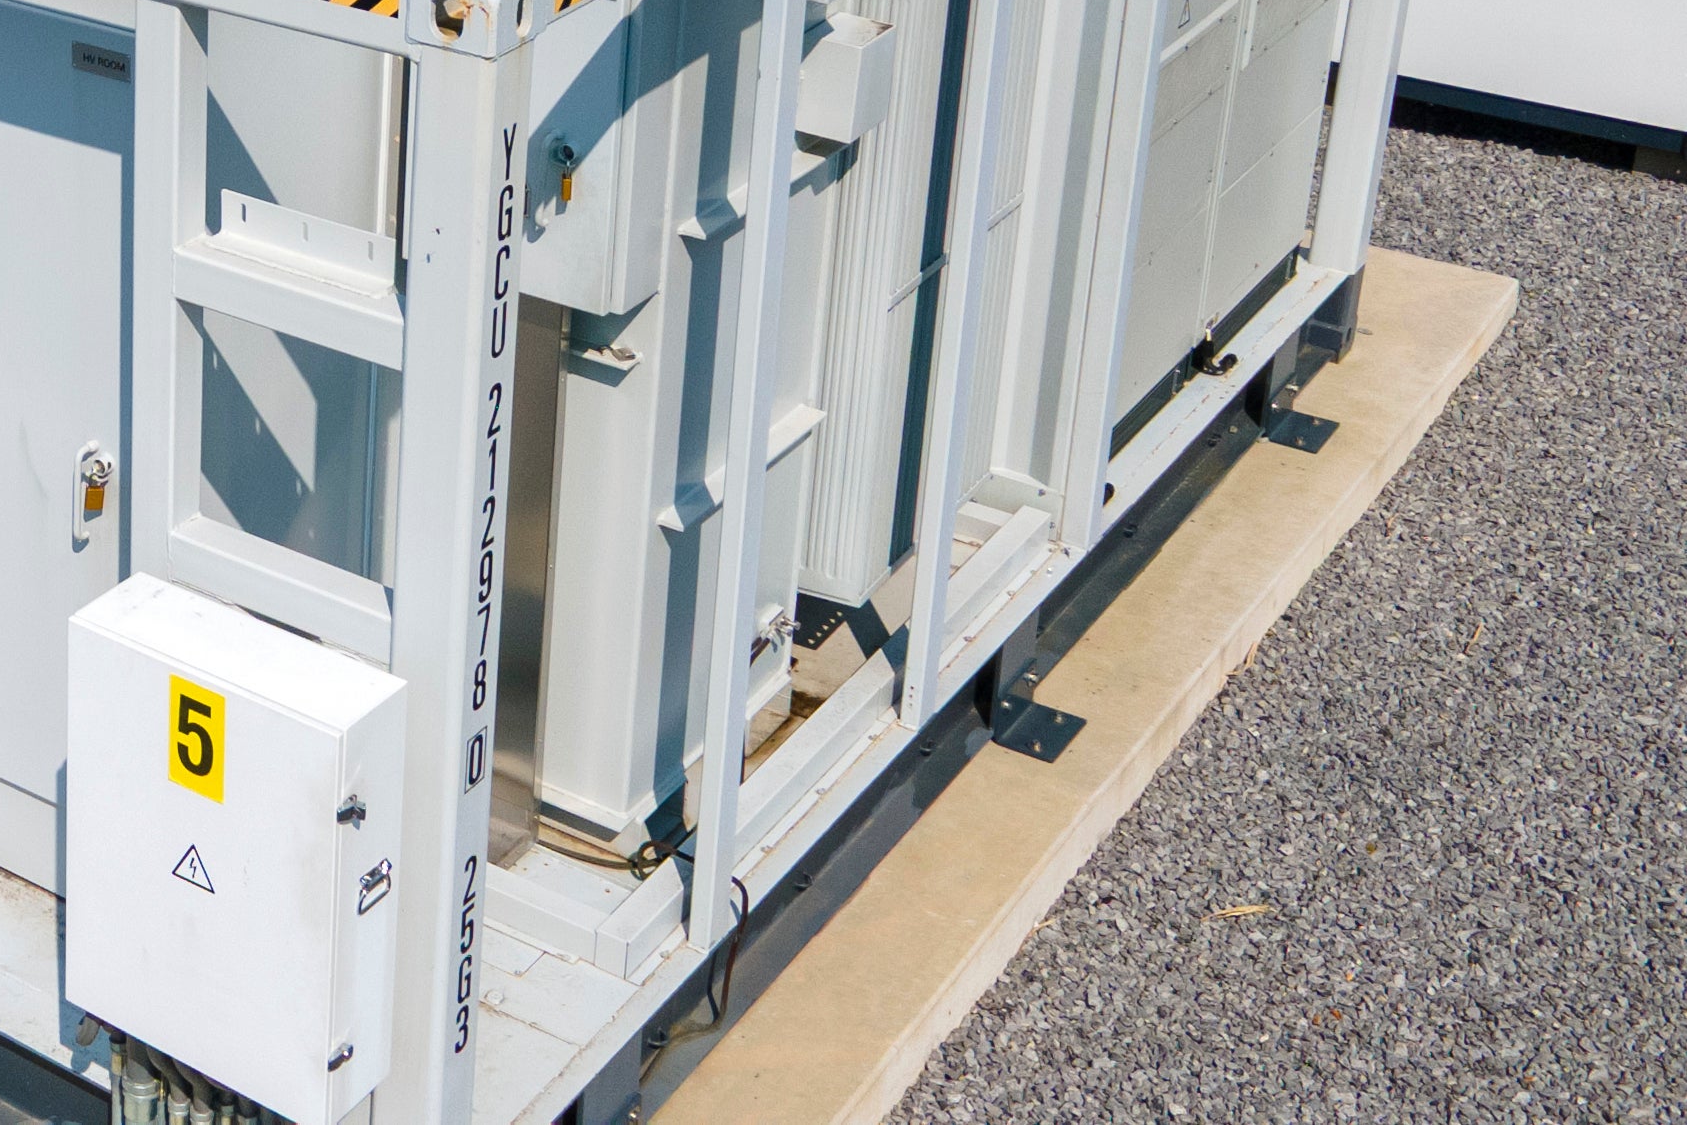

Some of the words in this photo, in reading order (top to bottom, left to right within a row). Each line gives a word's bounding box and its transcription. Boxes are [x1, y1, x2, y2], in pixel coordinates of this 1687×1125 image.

[82, 52, 95, 65] HV
[97, 56, 126, 73] ROOM
[491, 123, 517, 359] YGCU
[472, 382, 502, 711] 212978
[177, 694, 214, 777] 5
[468, 732, 483, 786] 0
[454, 855, 477, 1055] 25G3
